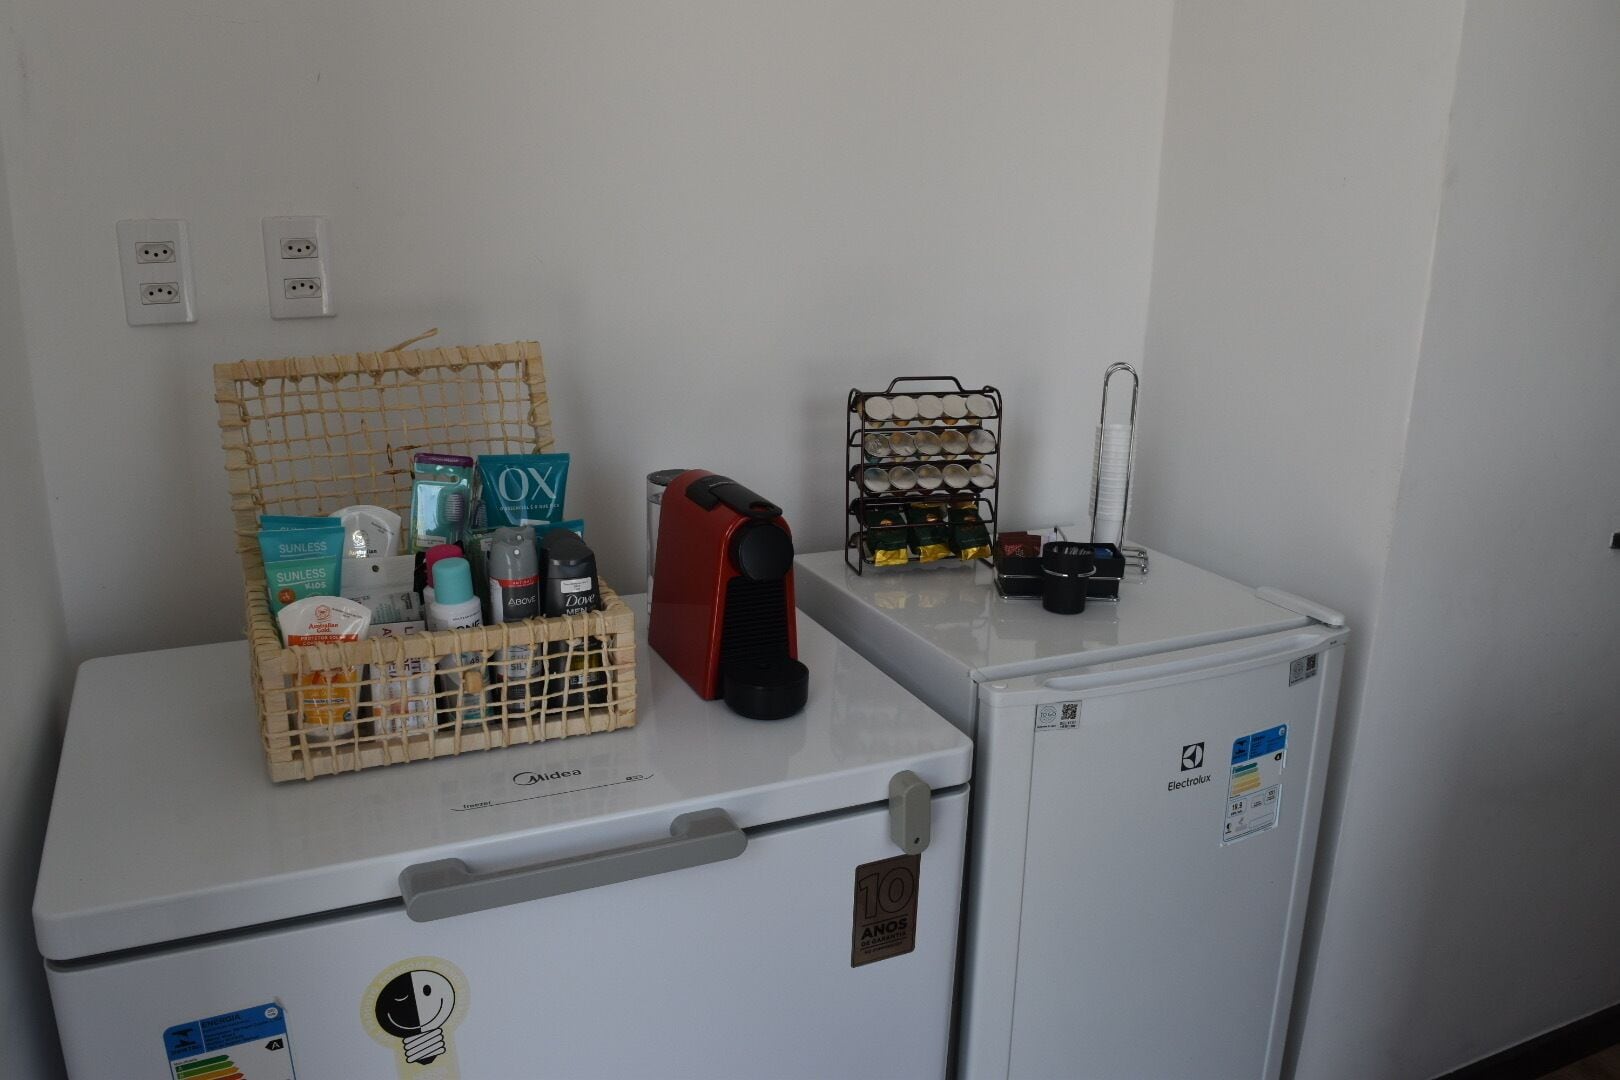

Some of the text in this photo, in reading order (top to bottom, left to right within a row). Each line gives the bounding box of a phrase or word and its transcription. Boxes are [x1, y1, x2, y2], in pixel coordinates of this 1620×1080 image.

[498, 465, 558, 502] OX
[278, 541, 328, 555] SUNLESS
[276, 567, 327, 583] SUNLESS
[304, 581, 327, 590] KIDS
[508, 595, 536, 606] ABOVE
[566, 594, 595, 607] Dove
[567, 606, 588, 616] MEN
[512, 769, 582, 786] Midea
[1167, 774, 1212, 791] Electrolux
[463, 801, 491, 809] freezer
[859, 867, 915, 919] 10
[861, 917, 907, 940] ANOS
[202, 1014, 242, 1028] ENERGIA
[271, 1041, 280, 1051] A
